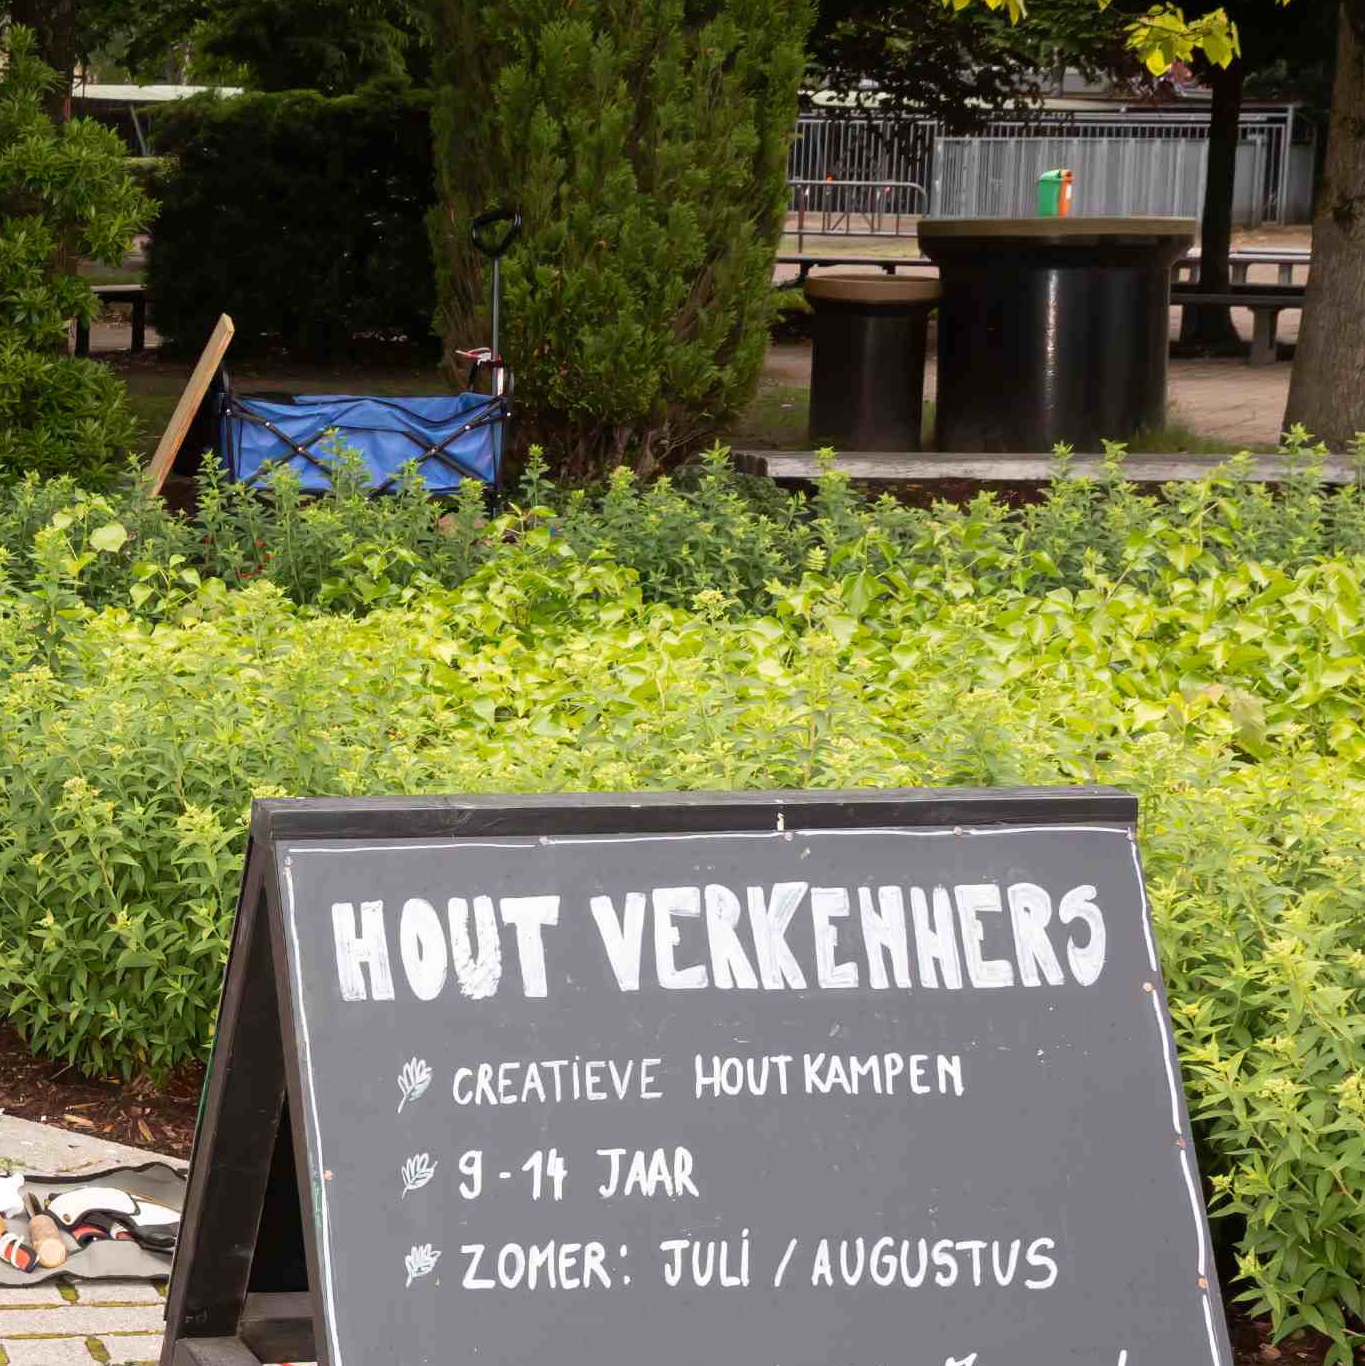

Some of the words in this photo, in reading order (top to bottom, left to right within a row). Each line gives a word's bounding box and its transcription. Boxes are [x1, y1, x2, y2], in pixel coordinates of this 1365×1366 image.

[331, 894, 561, 1002] HOUT
[589, 881, 1108, 991] VERKENNERS
[452, 1055, 664, 1106] CREATIEVE
[595, 1146, 700, 1199] JAAR
[460, 1239, 631, 1291] ZOMER:
[811, 1236, 1058, 1290] AUGUSTUS
